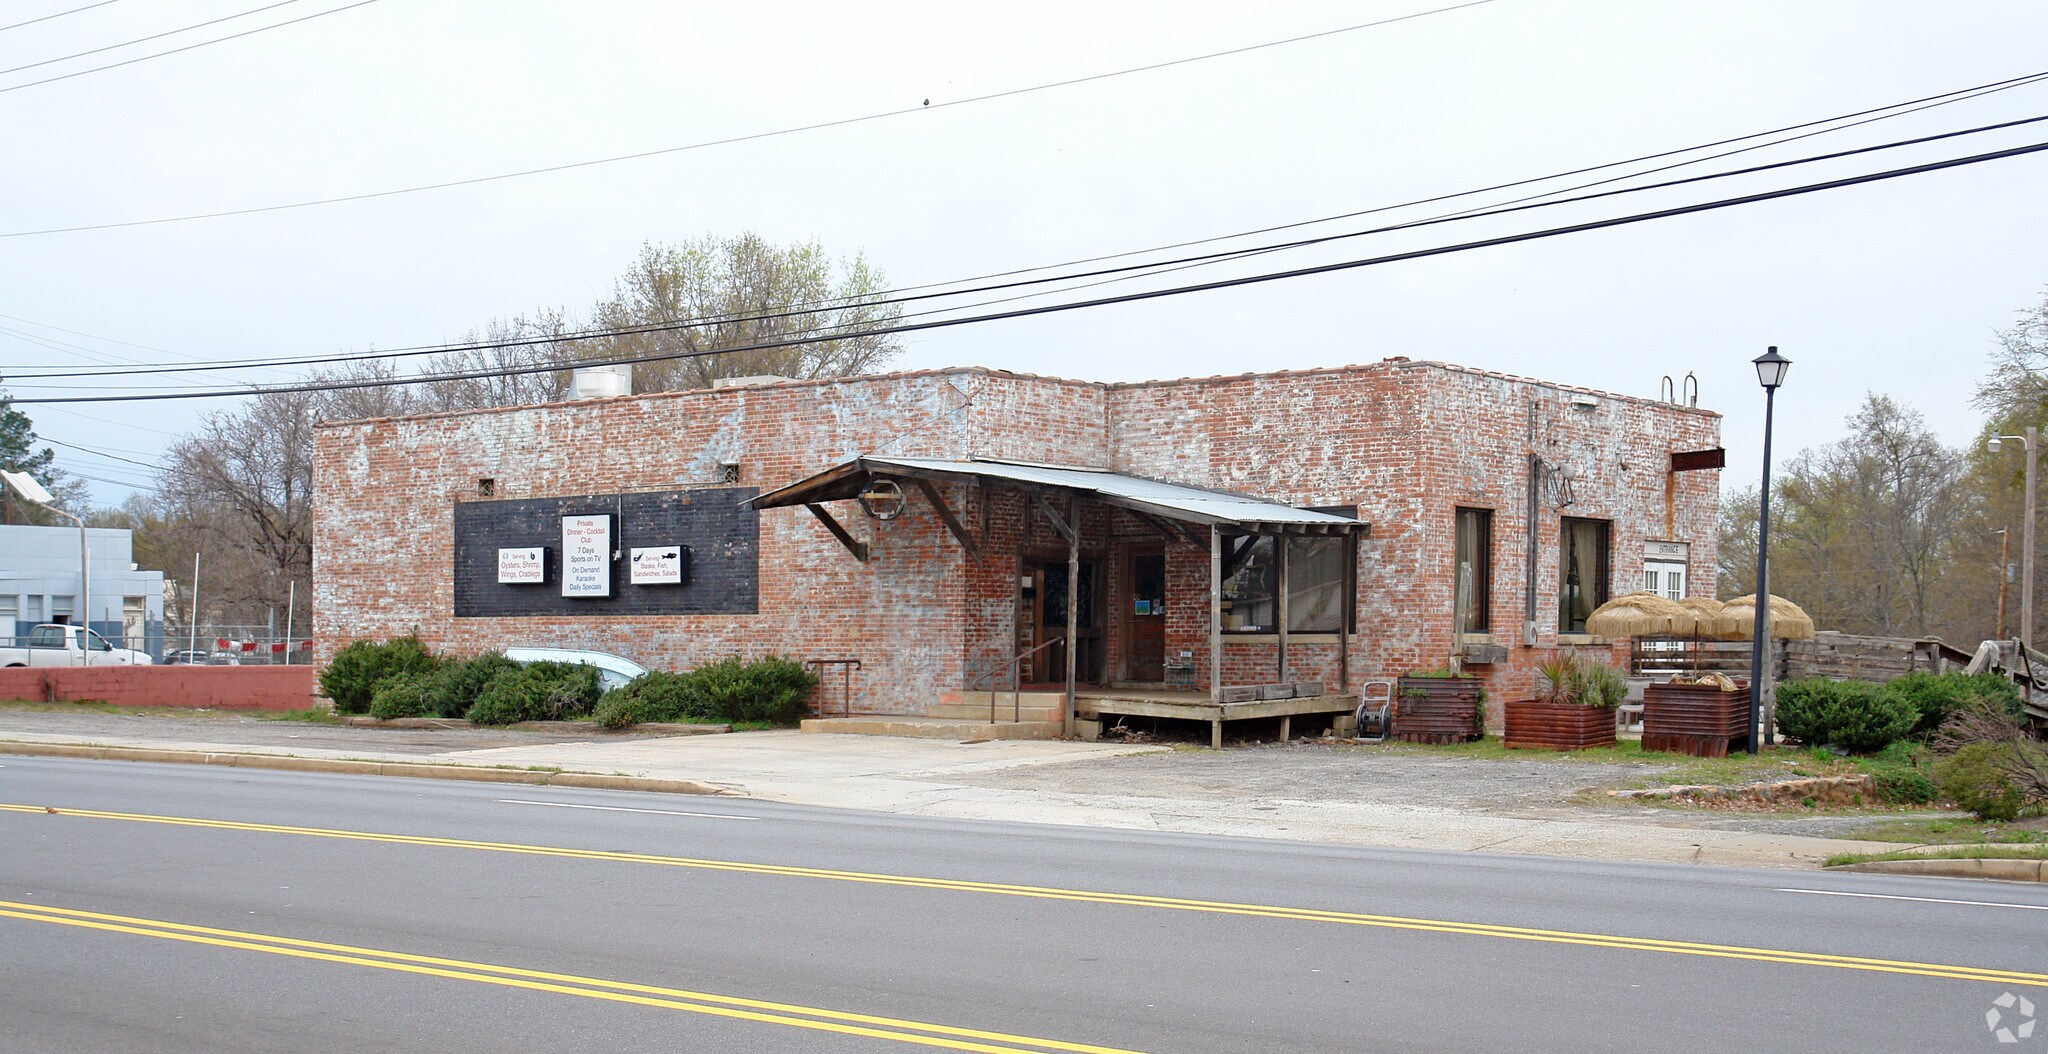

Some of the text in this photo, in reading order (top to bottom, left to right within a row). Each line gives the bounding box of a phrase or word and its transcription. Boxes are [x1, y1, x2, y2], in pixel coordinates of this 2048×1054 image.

[582, 547, 594, 555] Days
[1659, 544, 1678, 554] ENTRANCE
[519, 570, 540, 578] Crablegs
